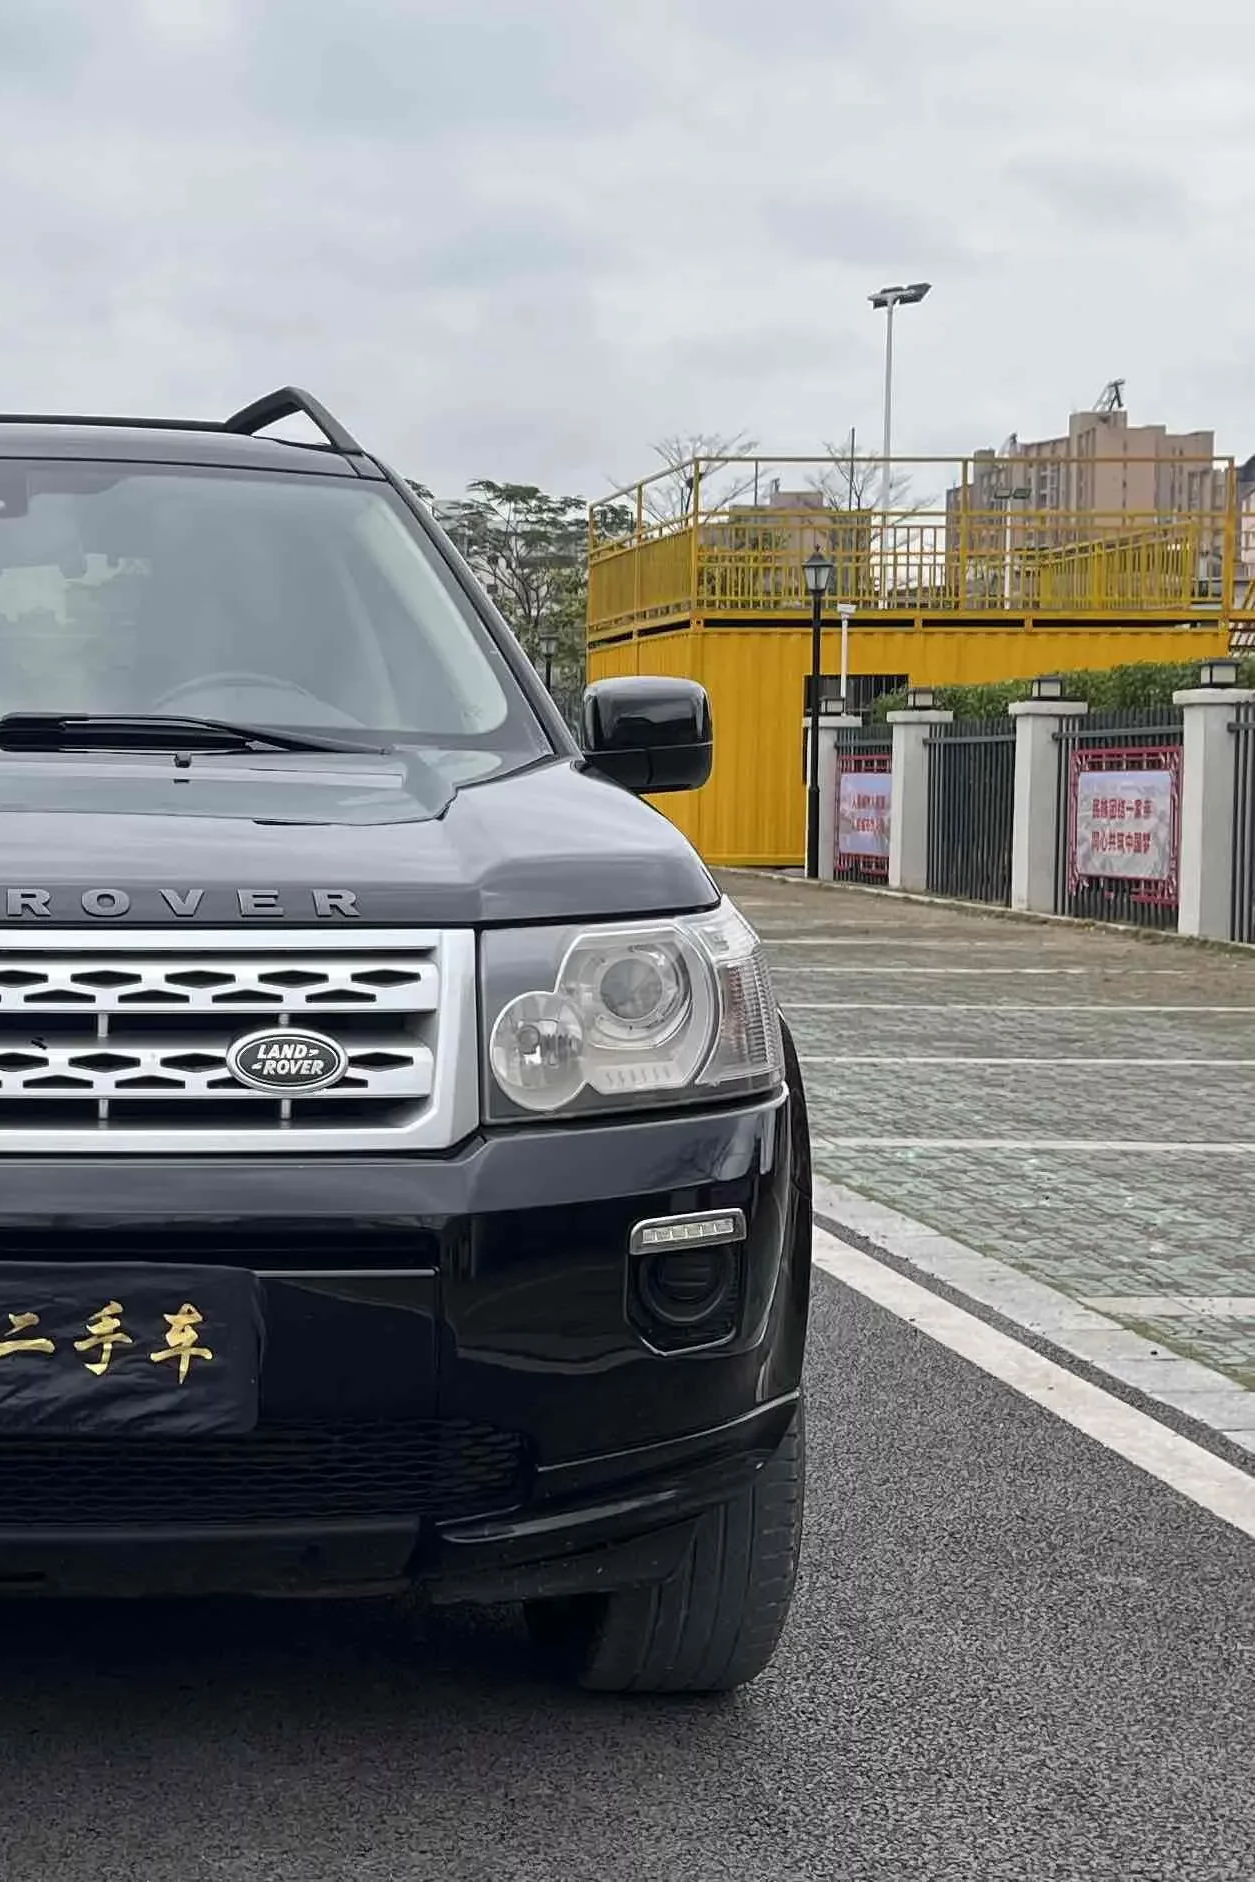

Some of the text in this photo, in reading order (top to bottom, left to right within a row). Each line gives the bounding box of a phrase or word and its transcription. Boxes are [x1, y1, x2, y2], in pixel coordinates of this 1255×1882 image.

[6, 887, 362, 918] ROVER
[257, 1044, 308, 1059] LAND
[262, 1060, 325, 1075] ROVER
